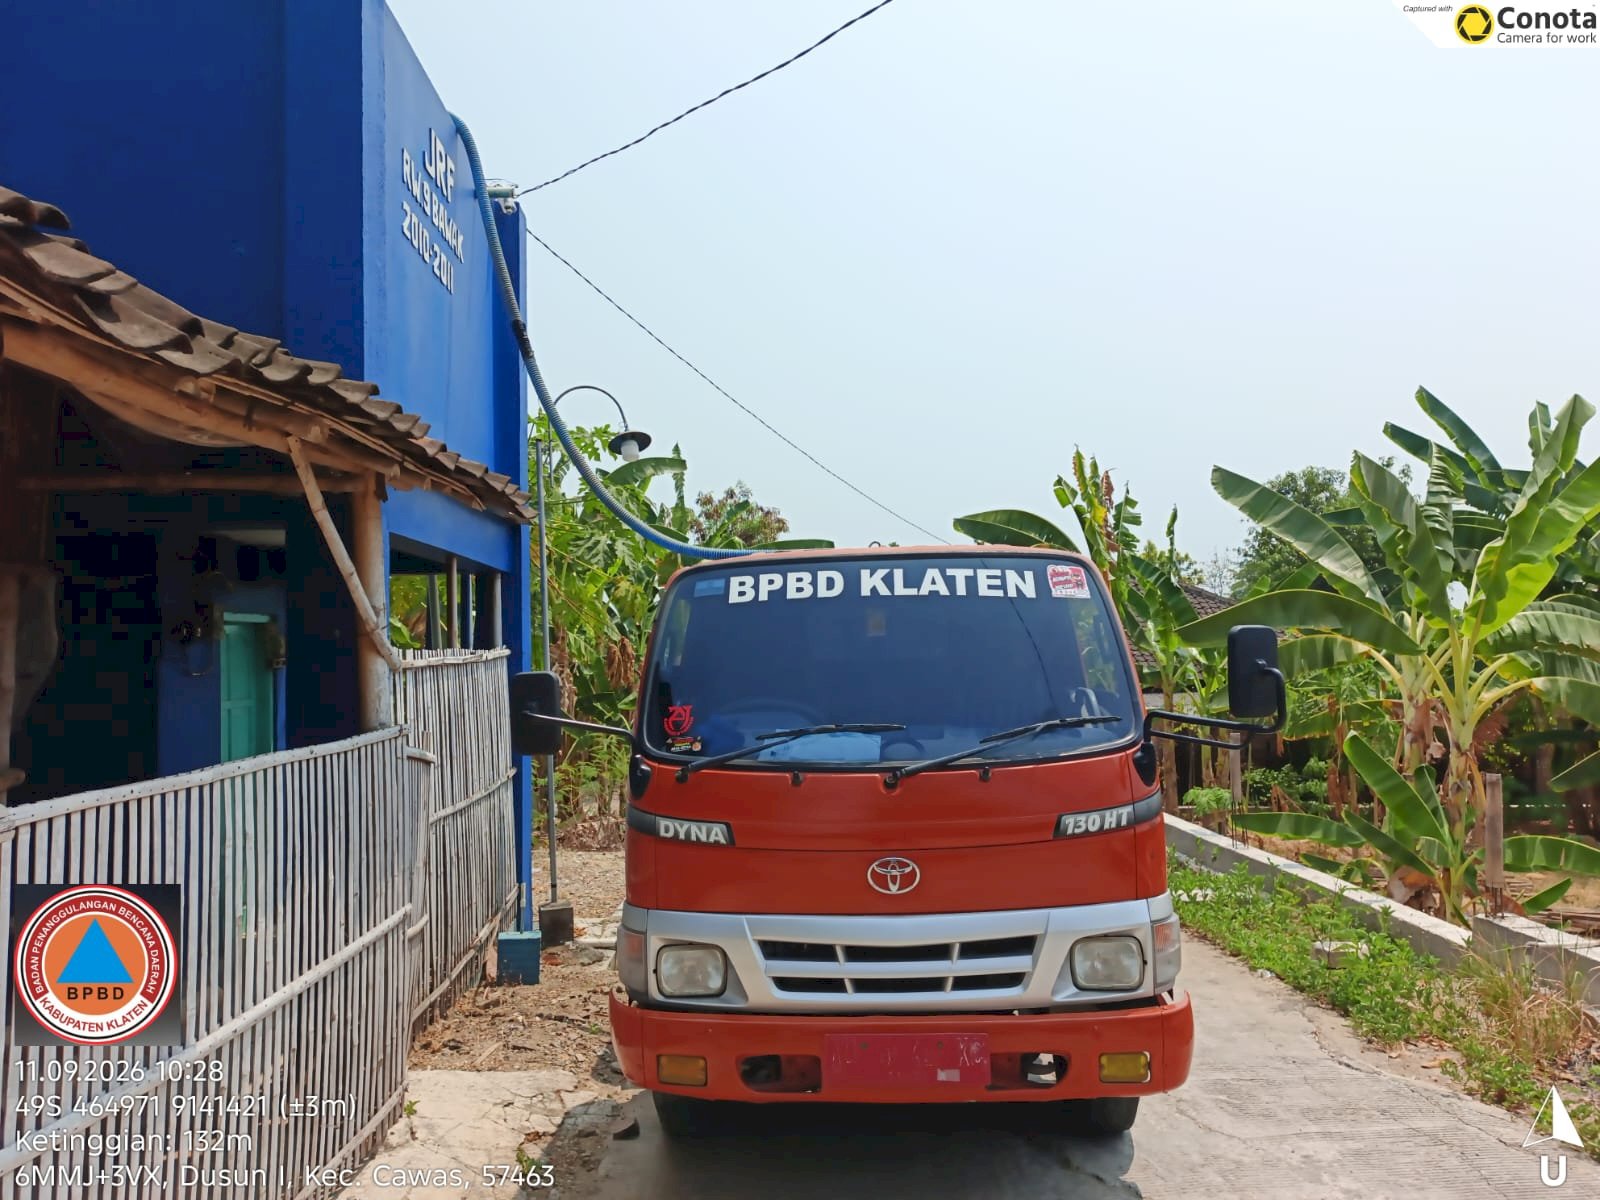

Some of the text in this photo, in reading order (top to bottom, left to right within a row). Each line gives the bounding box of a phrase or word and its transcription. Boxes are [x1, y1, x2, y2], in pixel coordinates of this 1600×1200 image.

[423, 128, 455, 203] JRF
[402, 201, 454, 295] 2010-2011
[432, 195, 464, 264] BAWAK
[728, 570, 844, 604] BPBD
[860, 568, 1036, 598] KLATEN
[659, 820, 727, 845] DYNA
[1065, 808, 1132, 836] 130 HT
